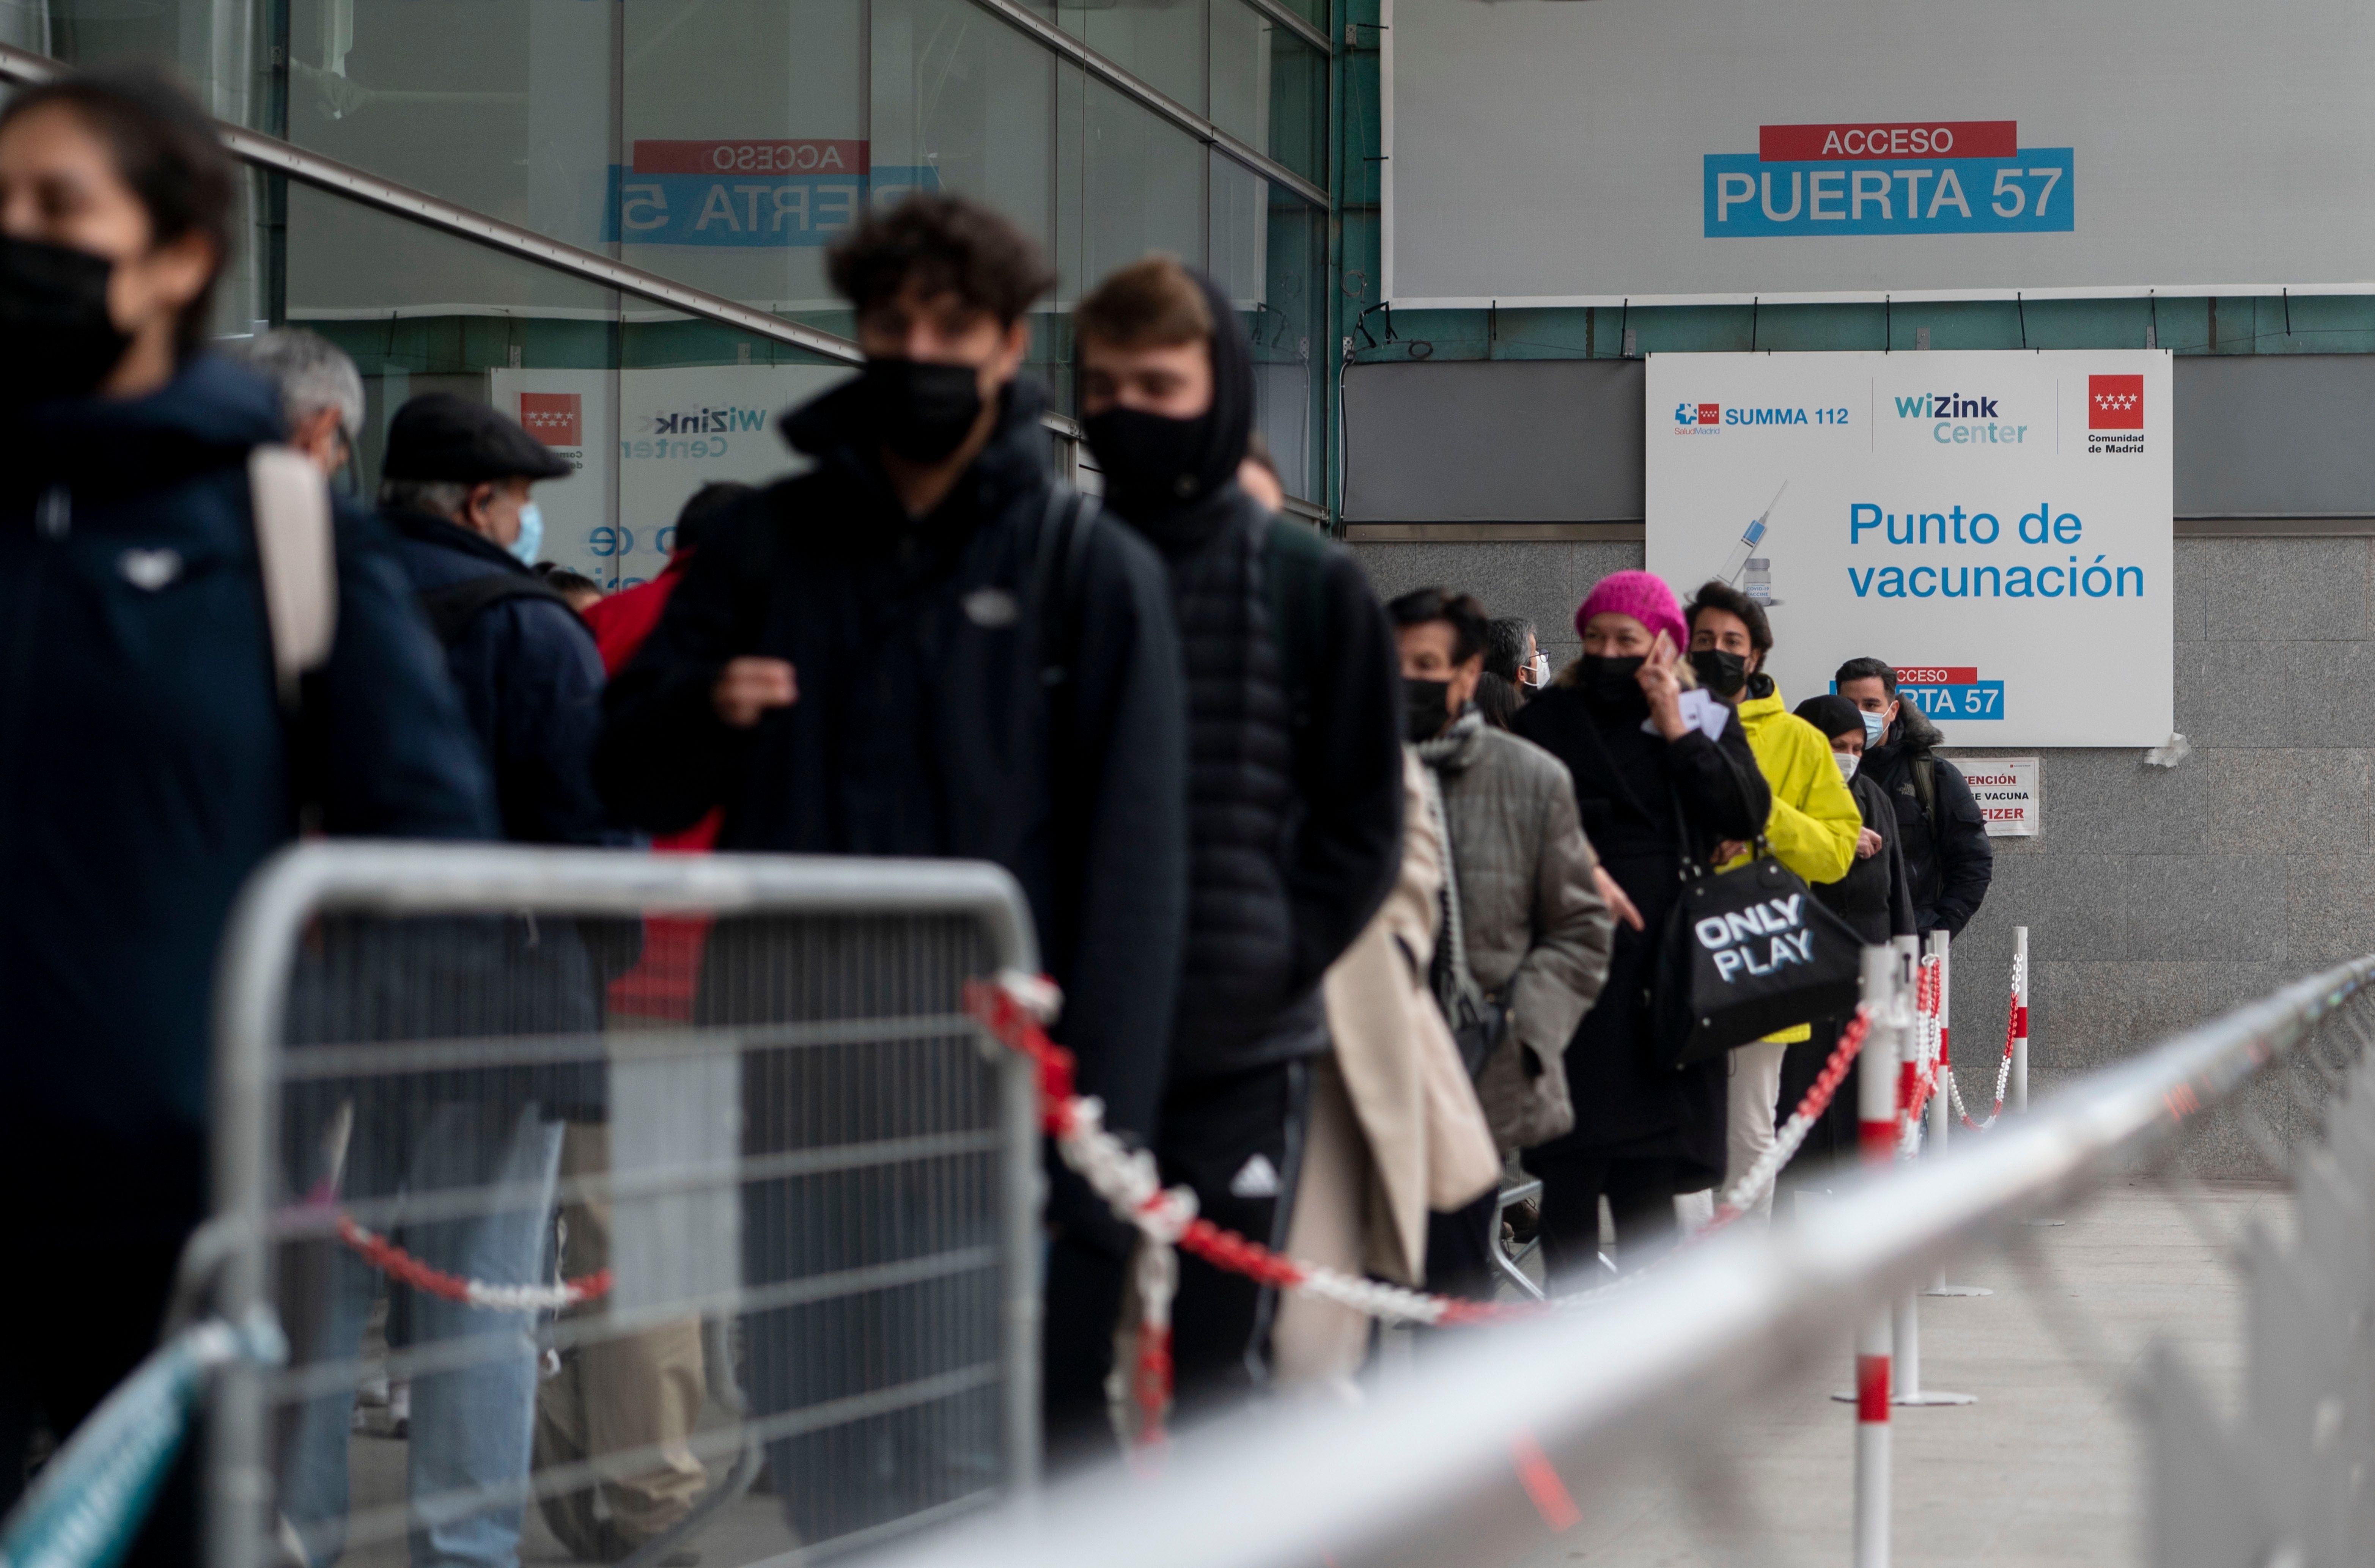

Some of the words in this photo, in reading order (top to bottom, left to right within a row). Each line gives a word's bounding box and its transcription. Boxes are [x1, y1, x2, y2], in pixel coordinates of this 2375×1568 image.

[1821, 128, 1953, 155] ACCESO
[1717, 168, 1972, 222] PUERTA
[1991, 167, 2063, 219] 57
[1725, 408, 1808, 425] SUMMA
[1815, 408, 1848, 424] 112
[1894, 393, 1999, 418] WiZink
[1933, 421, 2027, 444] Center
[2088, 445, 2101, 453] de
[2106, 445, 2144, 453] Madrid
[1851, 503, 1999, 545] Punto
[2018, 503, 2082, 545] de
[1848, 555, 2143, 598] vacunación
[1897, 670, 1948, 682] CCESO
[1899, 689, 1956, 713] RTA
[1965, 689, 1999, 713] 57
[1964, 773, 2016, 784] ENCIÓN
[1981, 808, 2024, 819] FIZER
[1695, 893, 1803, 949] ONLY
[1713, 928, 1813, 983] PLAY
